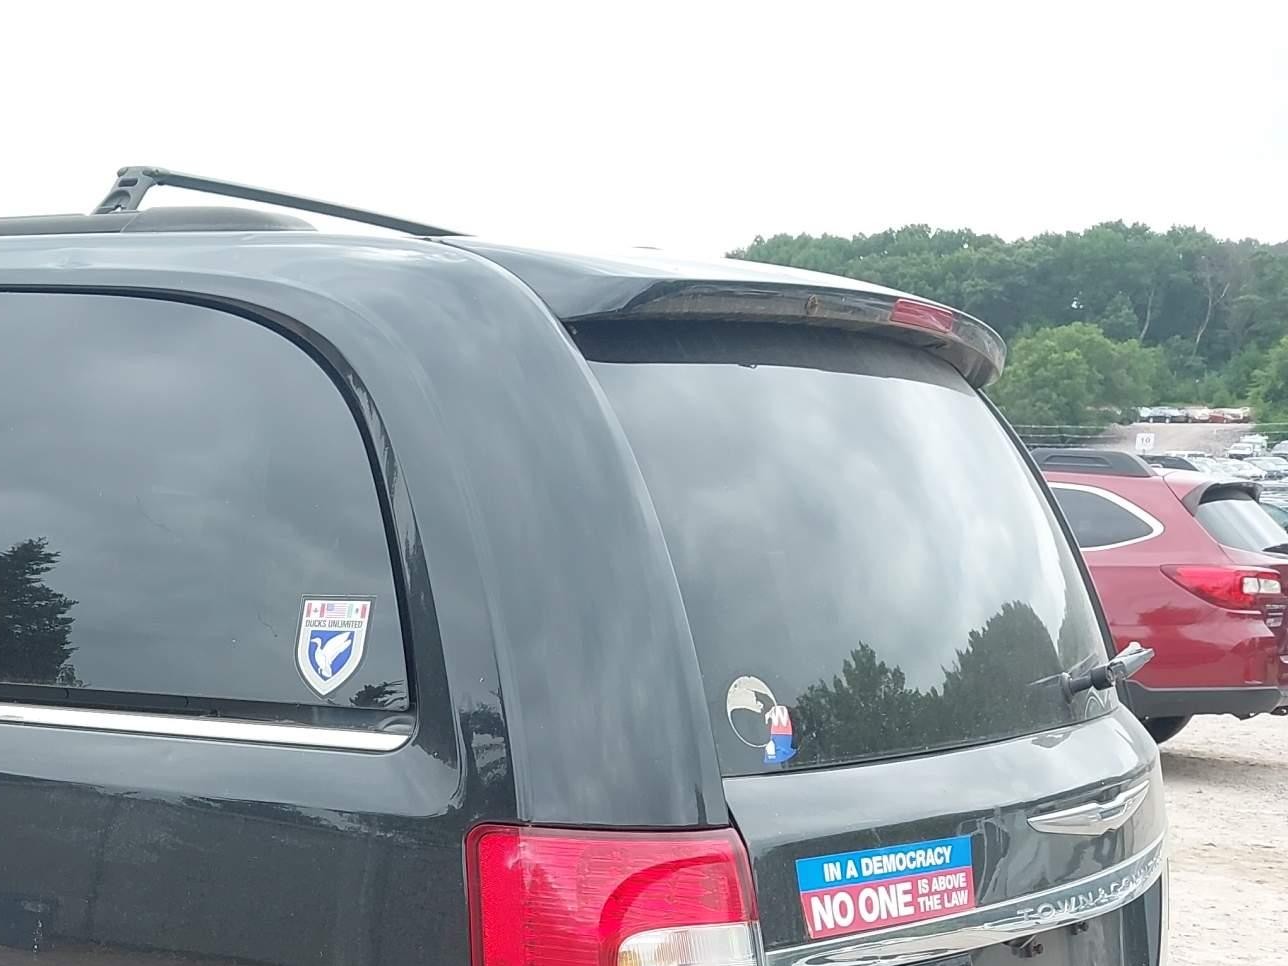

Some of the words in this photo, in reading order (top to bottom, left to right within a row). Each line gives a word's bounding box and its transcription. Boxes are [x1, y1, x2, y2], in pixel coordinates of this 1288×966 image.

[305, 619, 327, 628] DUCKS
[328, 620, 363, 629] UNLIMITED
[823, 862, 842, 882] IN
[846, 862, 859, 880] A
[861, 845, 952, 876] DEMOCRACY
[917, 880, 929, 895] IS
[931, 872, 968, 891] ABOVE
[811, 892, 855, 932] NO
[858, 881, 915, 923] ONE
[917, 897, 943, 913] THE
[944, 889, 969, 907] LAW
